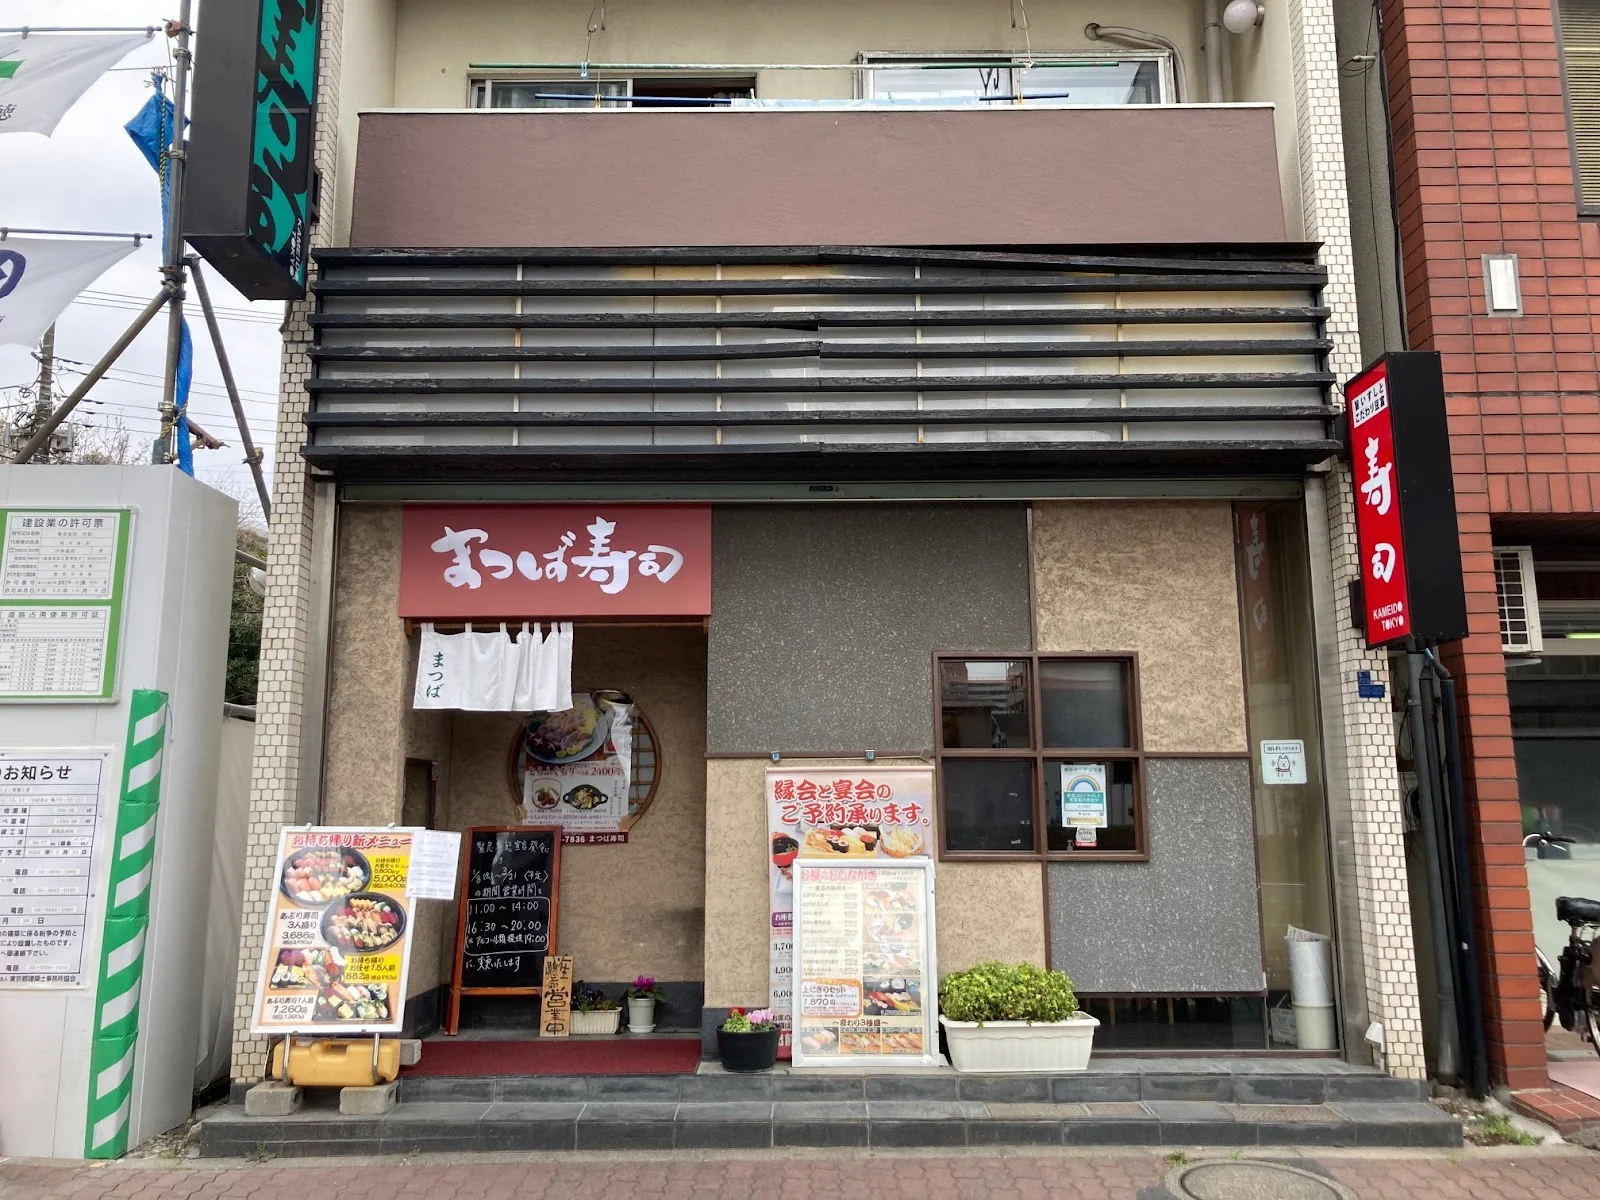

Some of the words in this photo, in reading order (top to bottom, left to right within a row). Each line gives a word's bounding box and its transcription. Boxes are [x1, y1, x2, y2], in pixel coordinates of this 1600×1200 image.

[1361, 437, 1396, 583] 寿司
[22, 518, 104, 528] 建設業の許可票
[431, 516, 684, 594] まつば寿司
[1373, 601, 1403, 620] KAMEIDO
[1381, 615, 1404, 631] TOKYO
[426, 652, 444, 699] まつば
[0, 765, 72, 780] お知らせ
[774, 779, 891, 801] 縁会と宴会の
[781, 802, 930, 825] ご予約承ります。
[292, 833, 412, 849] お持ち帰り新メニュー
[589, 835, 625, 843] まつば寿司
[512, 901, 539, 912] 14:00
[280, 912, 319, 920] あぶり寿司
[287, 921, 317, 929] 3人盛り
[511, 920, 541, 931] 20:00
[802, 985, 846, 993] 上にぎりセット
